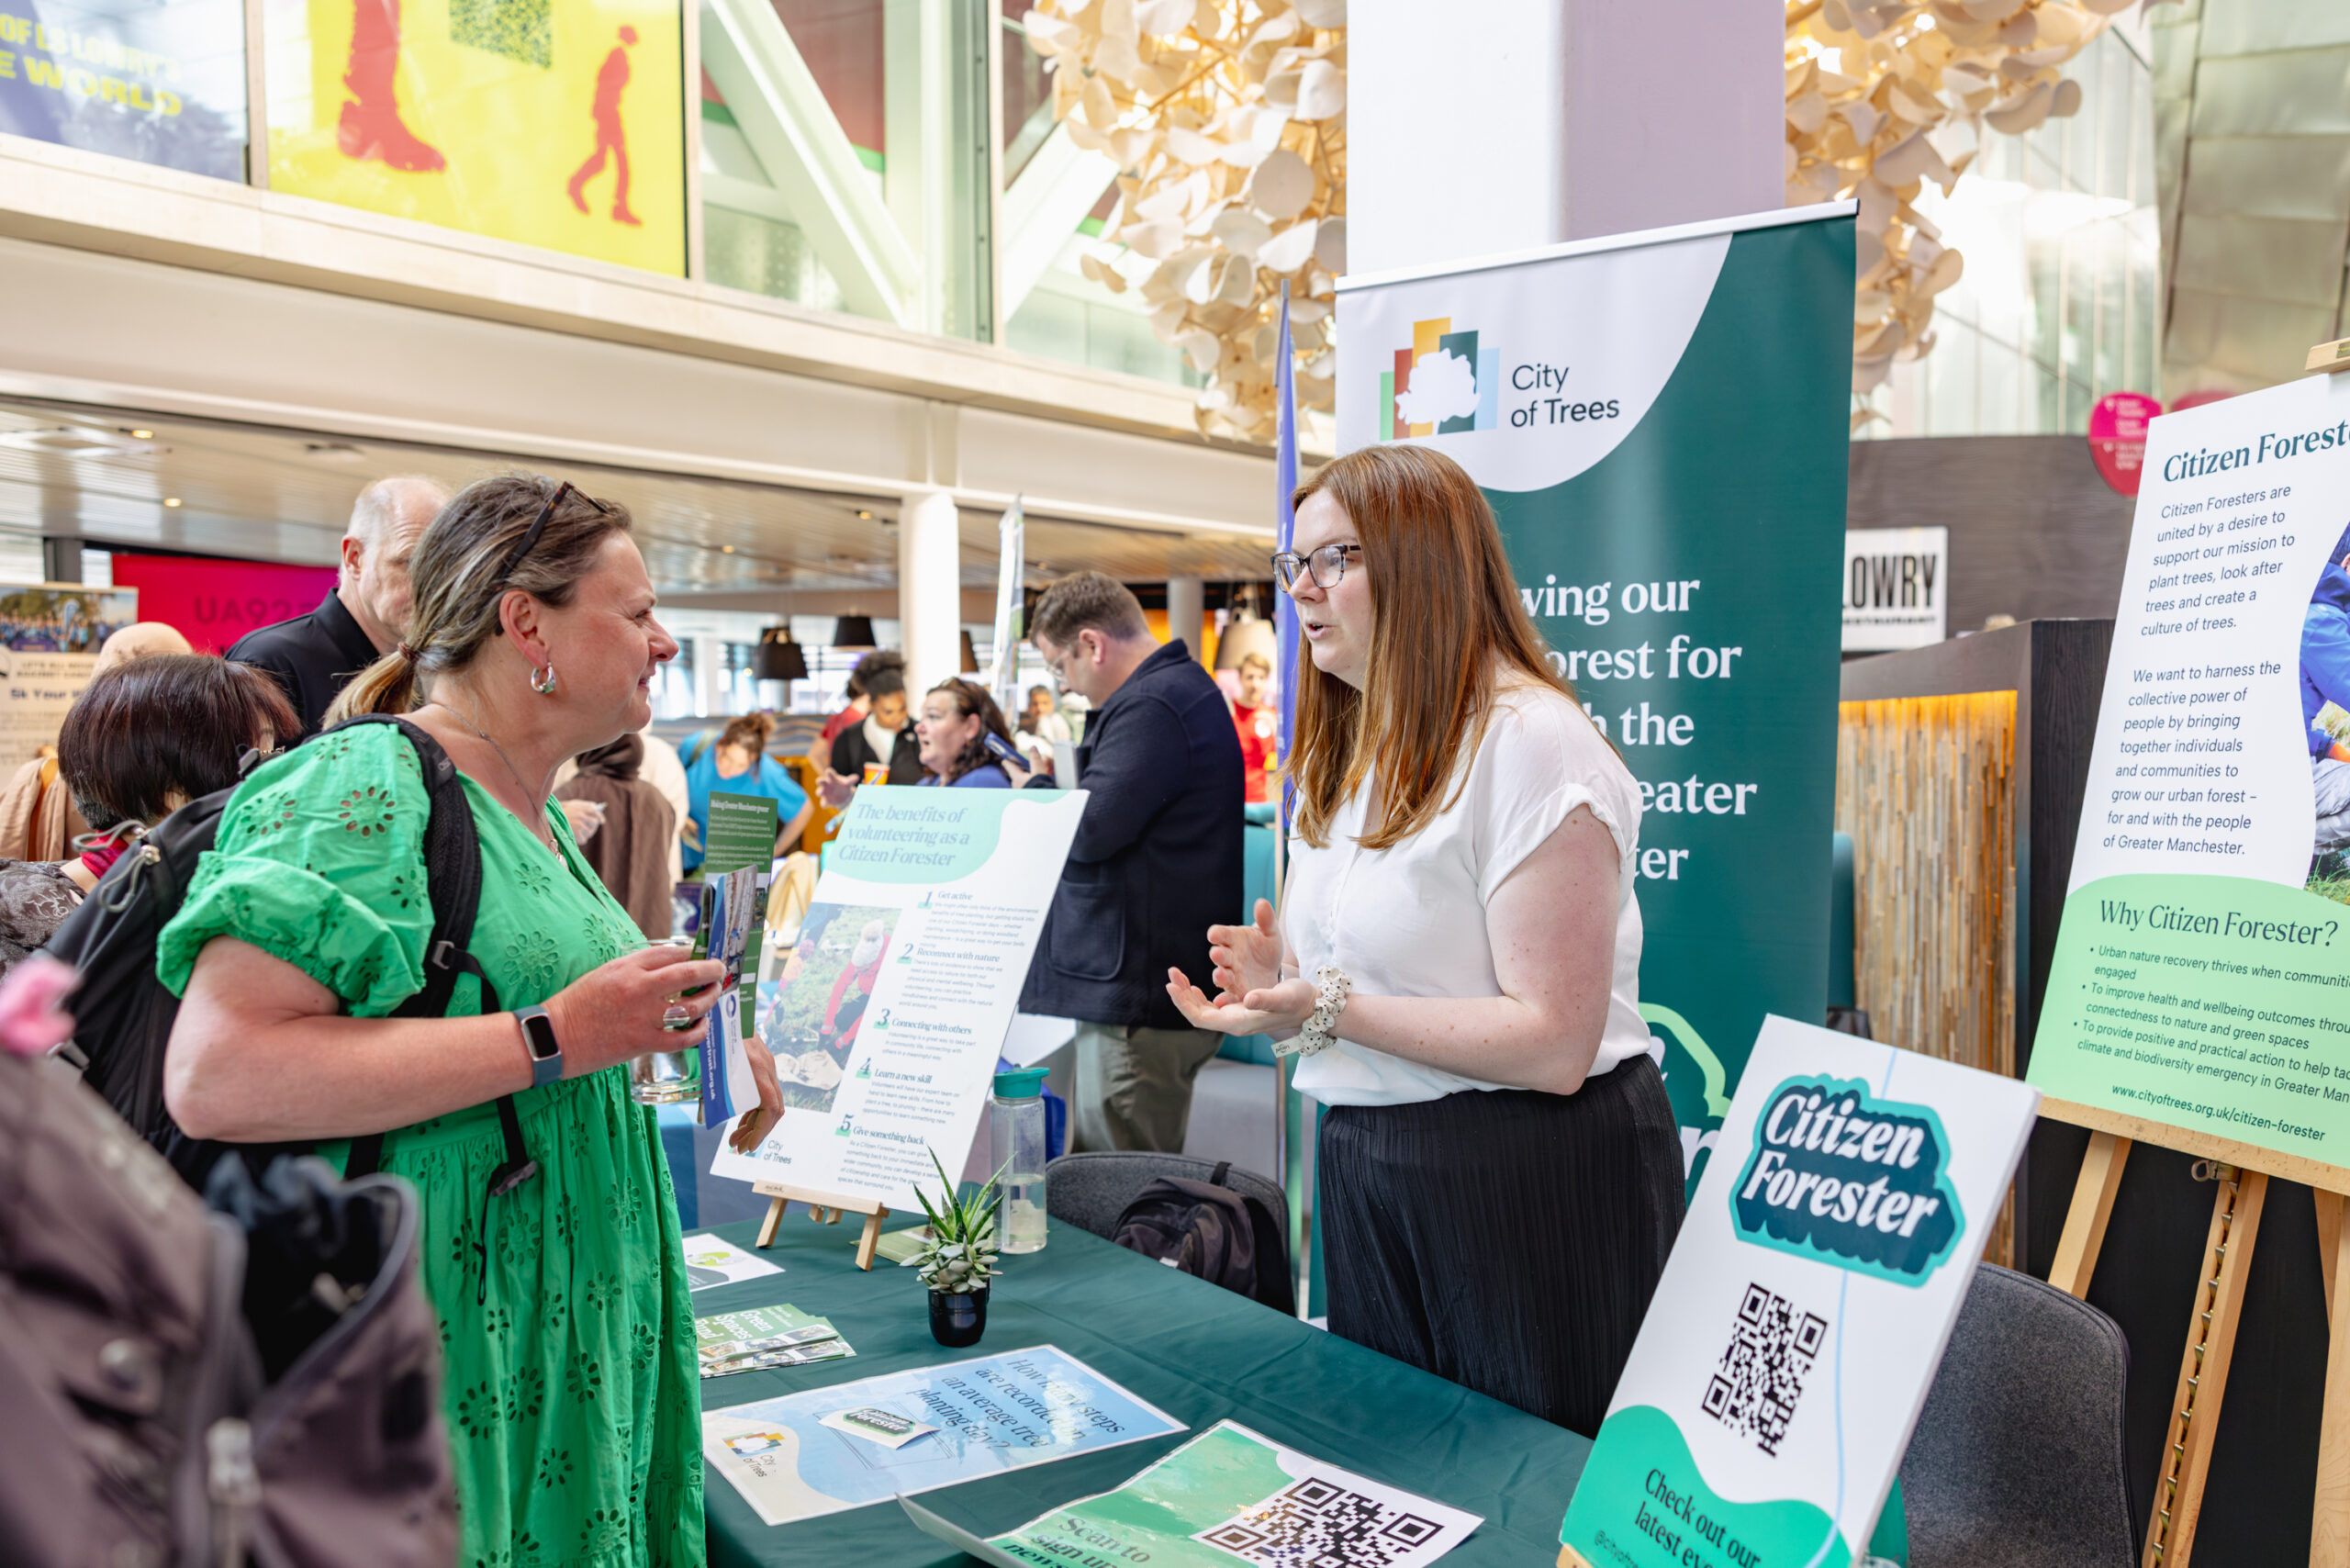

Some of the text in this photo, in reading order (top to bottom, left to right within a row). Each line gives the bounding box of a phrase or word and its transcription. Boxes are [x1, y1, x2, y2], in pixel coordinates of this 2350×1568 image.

[23, 55, 182, 116] WORLD
[1512, 364, 1570, 393] City
[1511, 398, 1619, 427] of Trees
[2164, 448, 2250, 482] Citizen
[2257, 420, 2350, 464] Forest
[2161, 486, 2291, 519] Citizen Foresters are
[2157, 511, 2286, 542] united by desire to
[2153, 535, 2295, 566] support our mission to
[1843, 554, 1937, 609] OWRY
[2149, 561, 2283, 591] plant trees, look after
[1621, 580, 1700, 613] our
[2145, 590, 2244, 612] trees and create
[2141, 617, 2236, 635] culture of trees.
[1666, 634, 1742, 678] for
[2133, 661, 2281, 682] We want to harness the
[2128, 688, 2247, 706] collective power of
[1619, 702, 1695, 745] the
[2124, 713, 2240, 732] people by bringing
[2121, 738, 2243, 756] together individuals
[2116, 764, 2238, 777] and communities to
[1641, 774, 1758, 814] eater
[2111, 788, 2245, 803] grow our urban forest
[857, 804, 968, 823] The benefits of
[2108, 811, 2251, 832] for and with the people
[848, 824, 957, 846] volunteering as
[2103, 834, 2244, 855] of Greater Manchester.
[839, 844, 956, 866] Citizen Forester
[938, 891, 972, 901] Get active
[2101, 900, 2338, 946] Why Citizen Forester?
[917, 947, 1000, 962] Reconnect with nature
[2098, 945, 2350, 989] Urban nature recovery thrives when communiti
[2095, 966, 2137, 980] engaged
[2091, 982, 2103, 994] To
[2106, 984, 2145, 1002] improve
[2147, 991, 2178, 1006] health
[2180, 998, 2201, 1010] and
[2203, 1001, 2255, 1021] wellbeing
[2257, 1010, 2315, 1028] outcomes
[892, 1018, 972, 1035] Connecting with others
[2086, 1003, 2310, 1049] connectedness to nature and green spaces
[2083, 1019, 2330, 1079] To provide positive and practical action to help
[875, 1069, 933, 1084] Learn new skill
[2077, 1039, 2112, 1055] climate
[2114, 1047, 2133, 1059] and
[2134, 1049, 2195, 1074] biodiversity
[2196, 1063, 2258, 1087] emergency
[2261, 1074, 2271, 1088] in
[2275, 1077, 2321, 1097] Greater
[2111, 1084, 2326, 1141] www.cityoftrees.org.uk/citizen-forester
[767, 1139, 783, 1151] City
[854, 1126, 924, 1146] Give something back
[1766, 1093, 1925, 1169] Citizen
[764, 1152, 791, 1164] of Trees
[1741, 1149, 1940, 1238] Forester
[712, 1314, 753, 1339] Spaces
[740, 1310, 774, 1332] Green
[975, 1367, 1005, 1383] are
[1058, 1424, 1086, 1441] on
[1008, 1359, 1044, 1381] How
[1078, 1403, 1125, 1434] steps
[906, 1388, 971, 1428] planting
[962, 1421, 1012, 1449] day?
[942, 1376, 1048, 1449] an average tree
[1635, 1501, 1683, 1557] latest
[1646, 1469, 1762, 1568] Check out our
[1031, 1534, 1083, 1559] sign
[1059, 1518, 1150, 1563] Scan to
